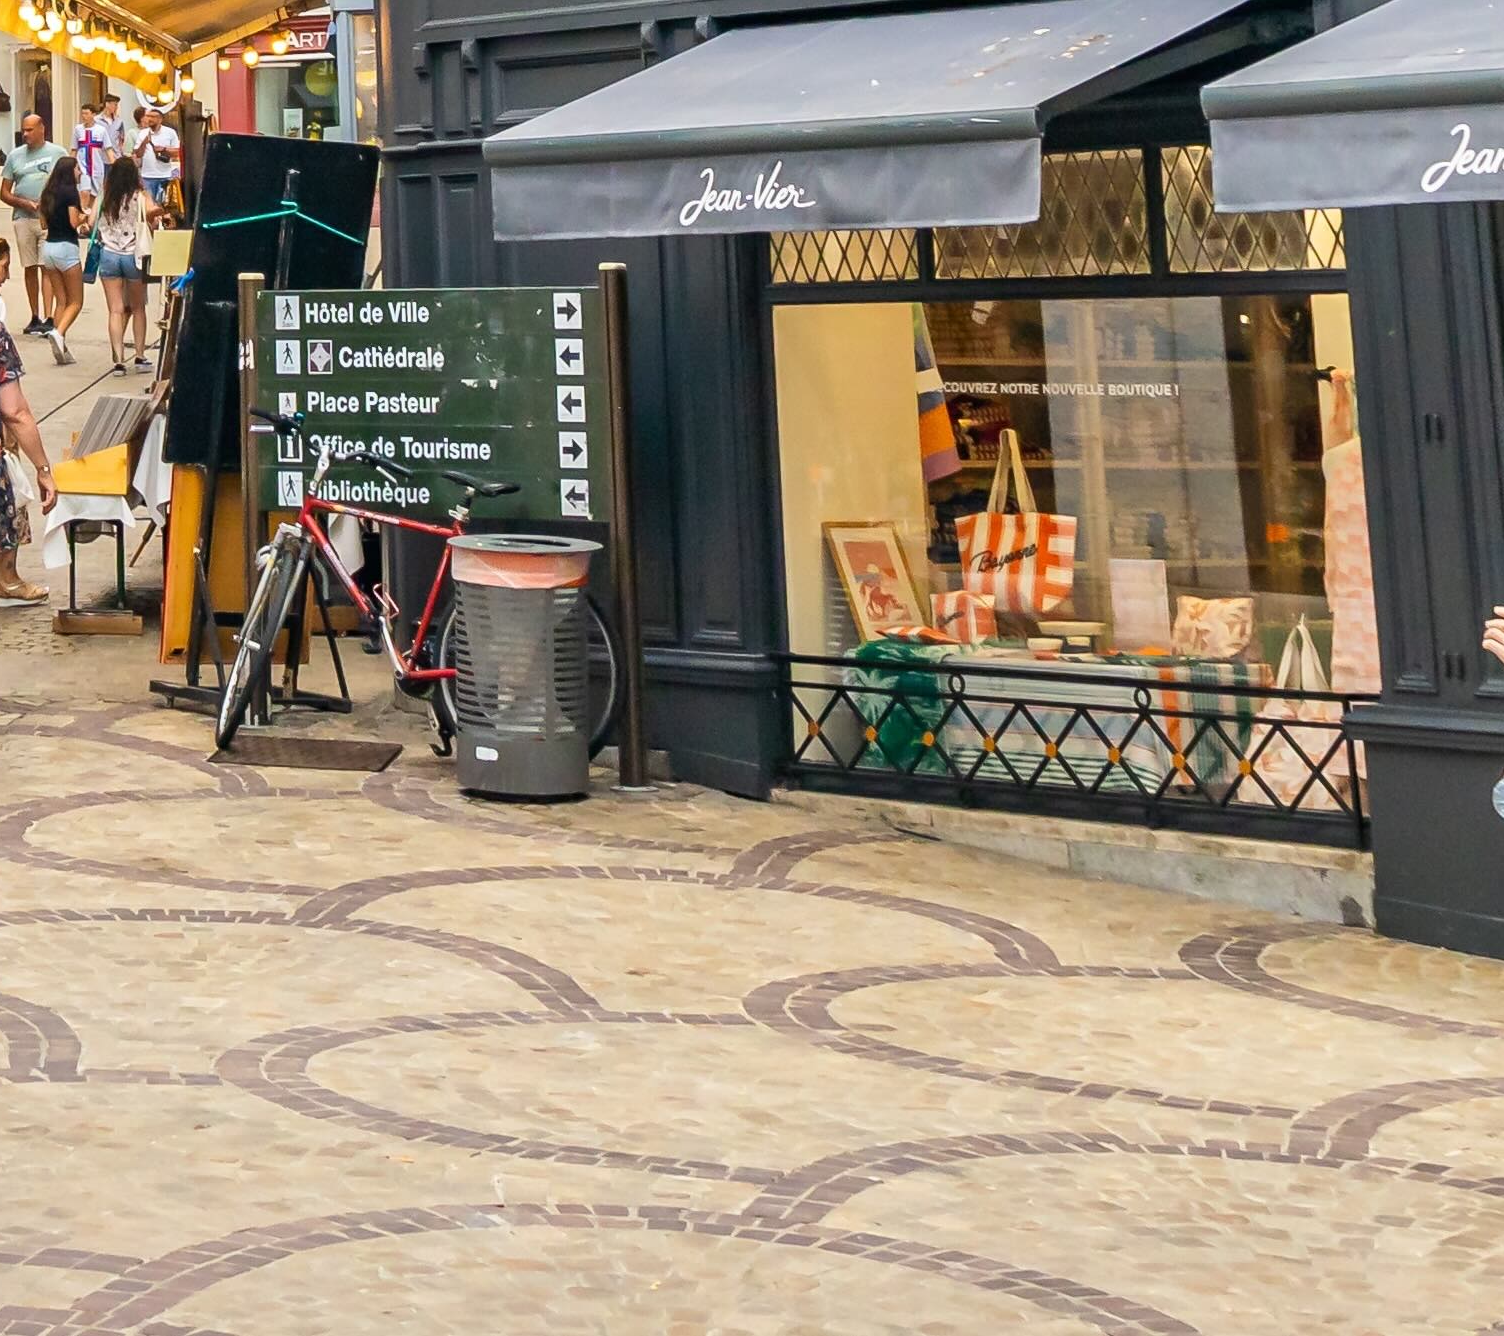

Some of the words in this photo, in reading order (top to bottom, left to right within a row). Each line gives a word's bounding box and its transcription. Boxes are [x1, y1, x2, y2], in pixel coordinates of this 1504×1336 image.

[679, 159, 817, 227] Jean-Vier
[304, 301, 354, 324] Hôtel
[359, 302, 384, 325] de
[388, 301, 430, 324] Ville
[338, 345, 445, 369] Cathédrale
[939, 381, 997, 394] COUVREZ
[1000, 382, 1040, 395] NOTRE
[1042, 382, 1105, 396] NOUVELLE
[1108, 382, 1173, 398] BOUTIQUE
[306, 391, 360, 414] Place
[364, 391, 441, 415] Pasteur
[370, 435, 396, 457] de
[400, 436, 492, 461] Tourisme
